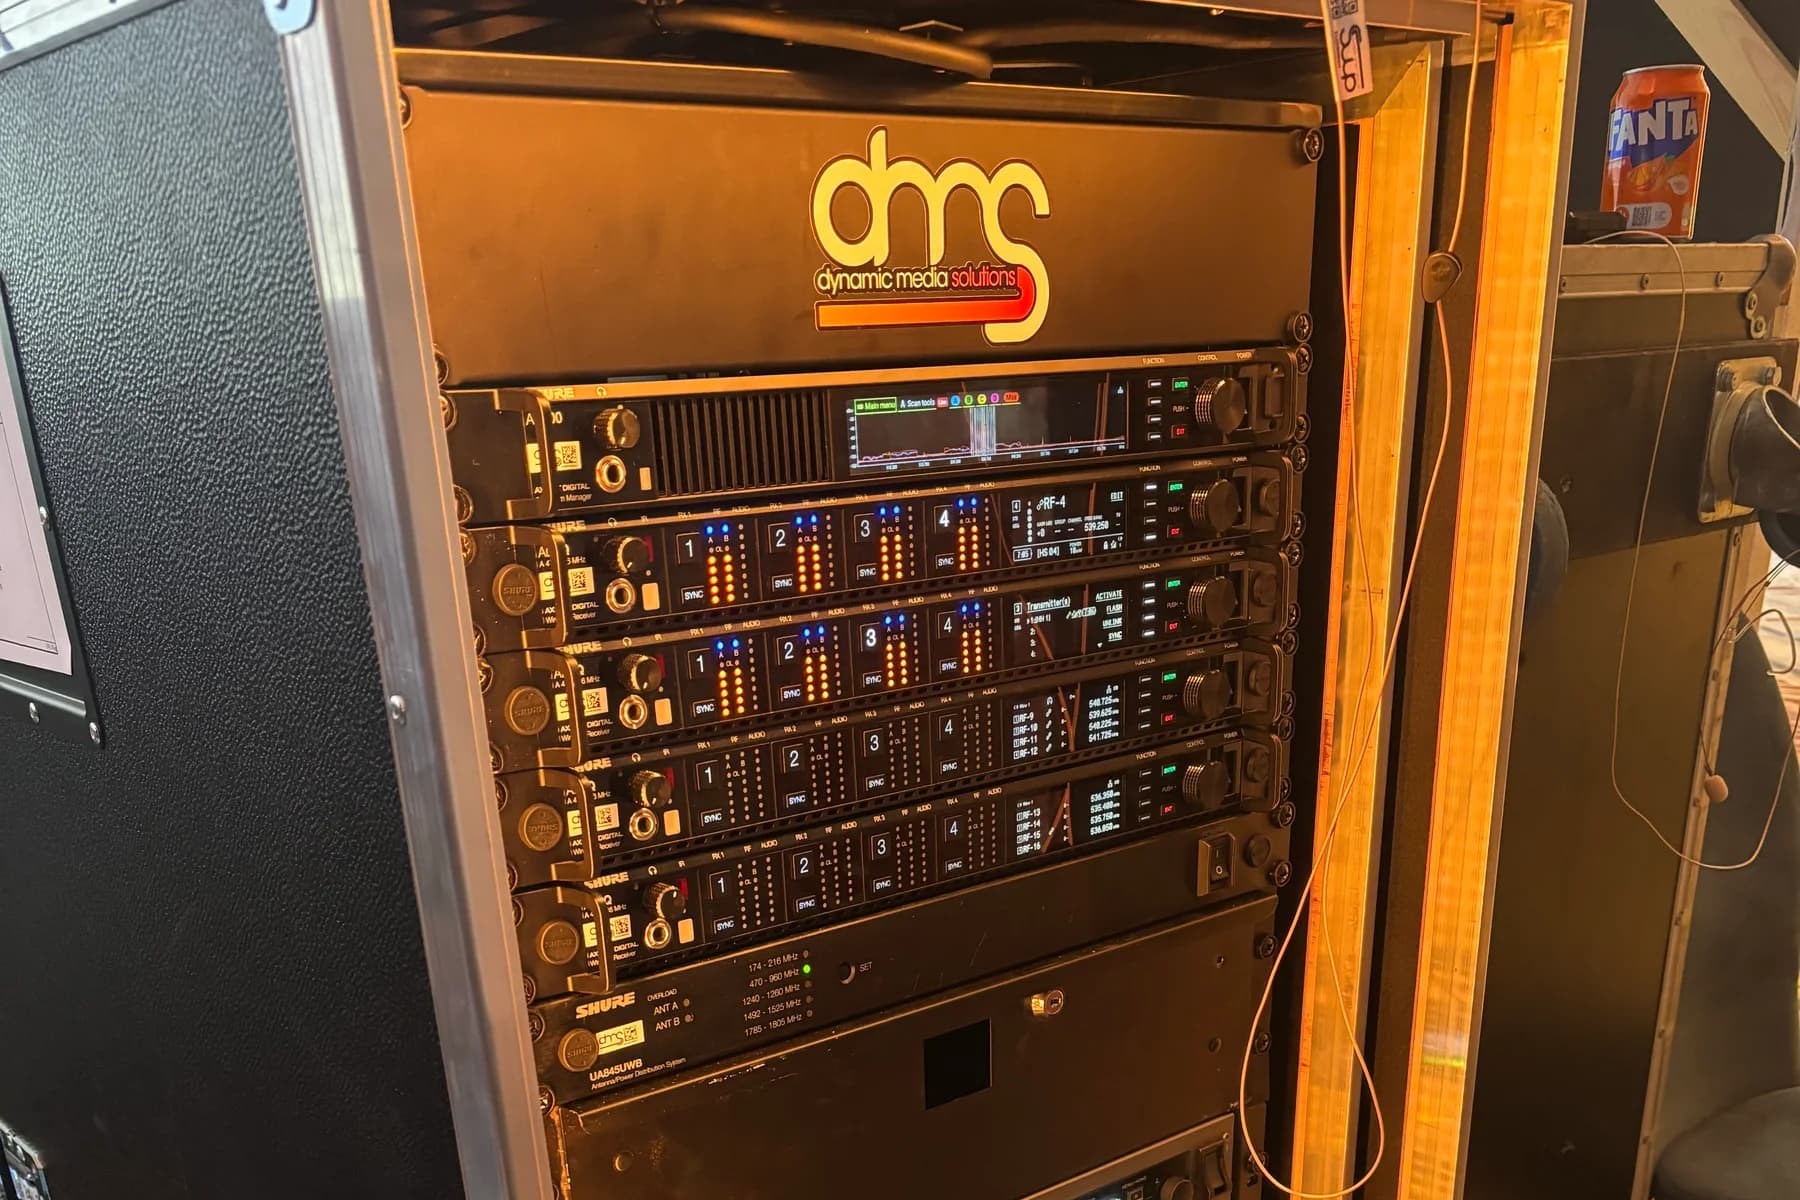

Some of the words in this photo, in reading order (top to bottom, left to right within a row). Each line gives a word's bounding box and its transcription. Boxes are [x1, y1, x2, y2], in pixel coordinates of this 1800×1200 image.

[1609, 99, 1698, 152] FANTA
[812, 127, 1050, 344] dms
[817, 268, 893, 295] dynamic
[896, 268, 948, 288] media
[951, 267, 1016, 288] solutions
[543, 387, 575, 400] URE
[1044, 495, 1066, 510] RF-4
[939, 509, 950, 527] 4
[860, 519, 871, 537] 3
[775, 529, 786, 547] 2
[685, 539, 693, 558] 1
[938, 557, 954, 567] SYNC
[859, 568, 877, 577] SYNC
[774, 578, 792, 588] SYNC
[684, 590, 704, 600] SYNC
[1096, 590, 1123, 602] ACTIVATE
[571, 602, 599, 611] DIGITAL
[943, 617, 952, 632] 4
[866, 628, 876, 647] 3
[784, 642, 794, 660] 2
[696, 655, 704, 673] 1
[941, 662, 957, 671] SYNC
[865, 675, 882, 685] SYNC
[783, 689, 800, 698] SYNC
[696, 704, 715, 713] SYNC
[586, 719, 613, 728] DIGITAL
[944, 720, 953, 735] 4
[870, 735, 879, 751] 3
[790, 750, 799, 767] 2
[942, 762, 958, 772] SYNC
[704, 767, 712, 784] 1
[868, 778, 884, 788] SYNC
[789, 795, 806, 805] SYNC
[704, 813, 722, 823] SYNC
[950, 821, 958, 835] 4
[877, 839, 886, 855] 3
[800, 857, 809, 874] 2
[948, 861, 962, 871] SYNC
[584, 872, 629, 889] SHURE
[718, 877, 725, 893] 1
[875, 880, 891, 890] SYNC
[799, 899, 815, 910] SYNC
[717, 920, 735, 931] SYNC
[613, 942, 639, 952] DIGITAL
[749, 964, 761, 972] 174
[768, 957, 782, 968] 216
[783, 953, 798, 963] MHz
[860, 961, 872, 972] SET
[750, 978, 763, 988] 470
[769, 972, 782, 982] 960
[784, 968, 799, 978] MHz
[647, 989, 677, 1002] OVERLOAD
[742, 995, 760, 1006] 1240
[785, 984, 800, 994] MHz
[576, 992, 635, 1019] SHURE
[654, 1003, 670, 1016] ANT
[672, 1001, 679, 1010] A
[744, 1010, 760, 1021] 1492
[786, 1000, 801, 1010] MHz
[655, 1019, 672, 1031] ANT
[673, 1017, 680, 1026] B
[745, 1025, 762, 1037] 1785
[787, 1014, 802, 1024] MHz
[590, 1058, 643, 1081] UA845UWB
[592, 1074, 634, 1090] Antenna/Power
[635, 1063, 665, 1077] Distribution
[666, 1057, 686, 1068] System
